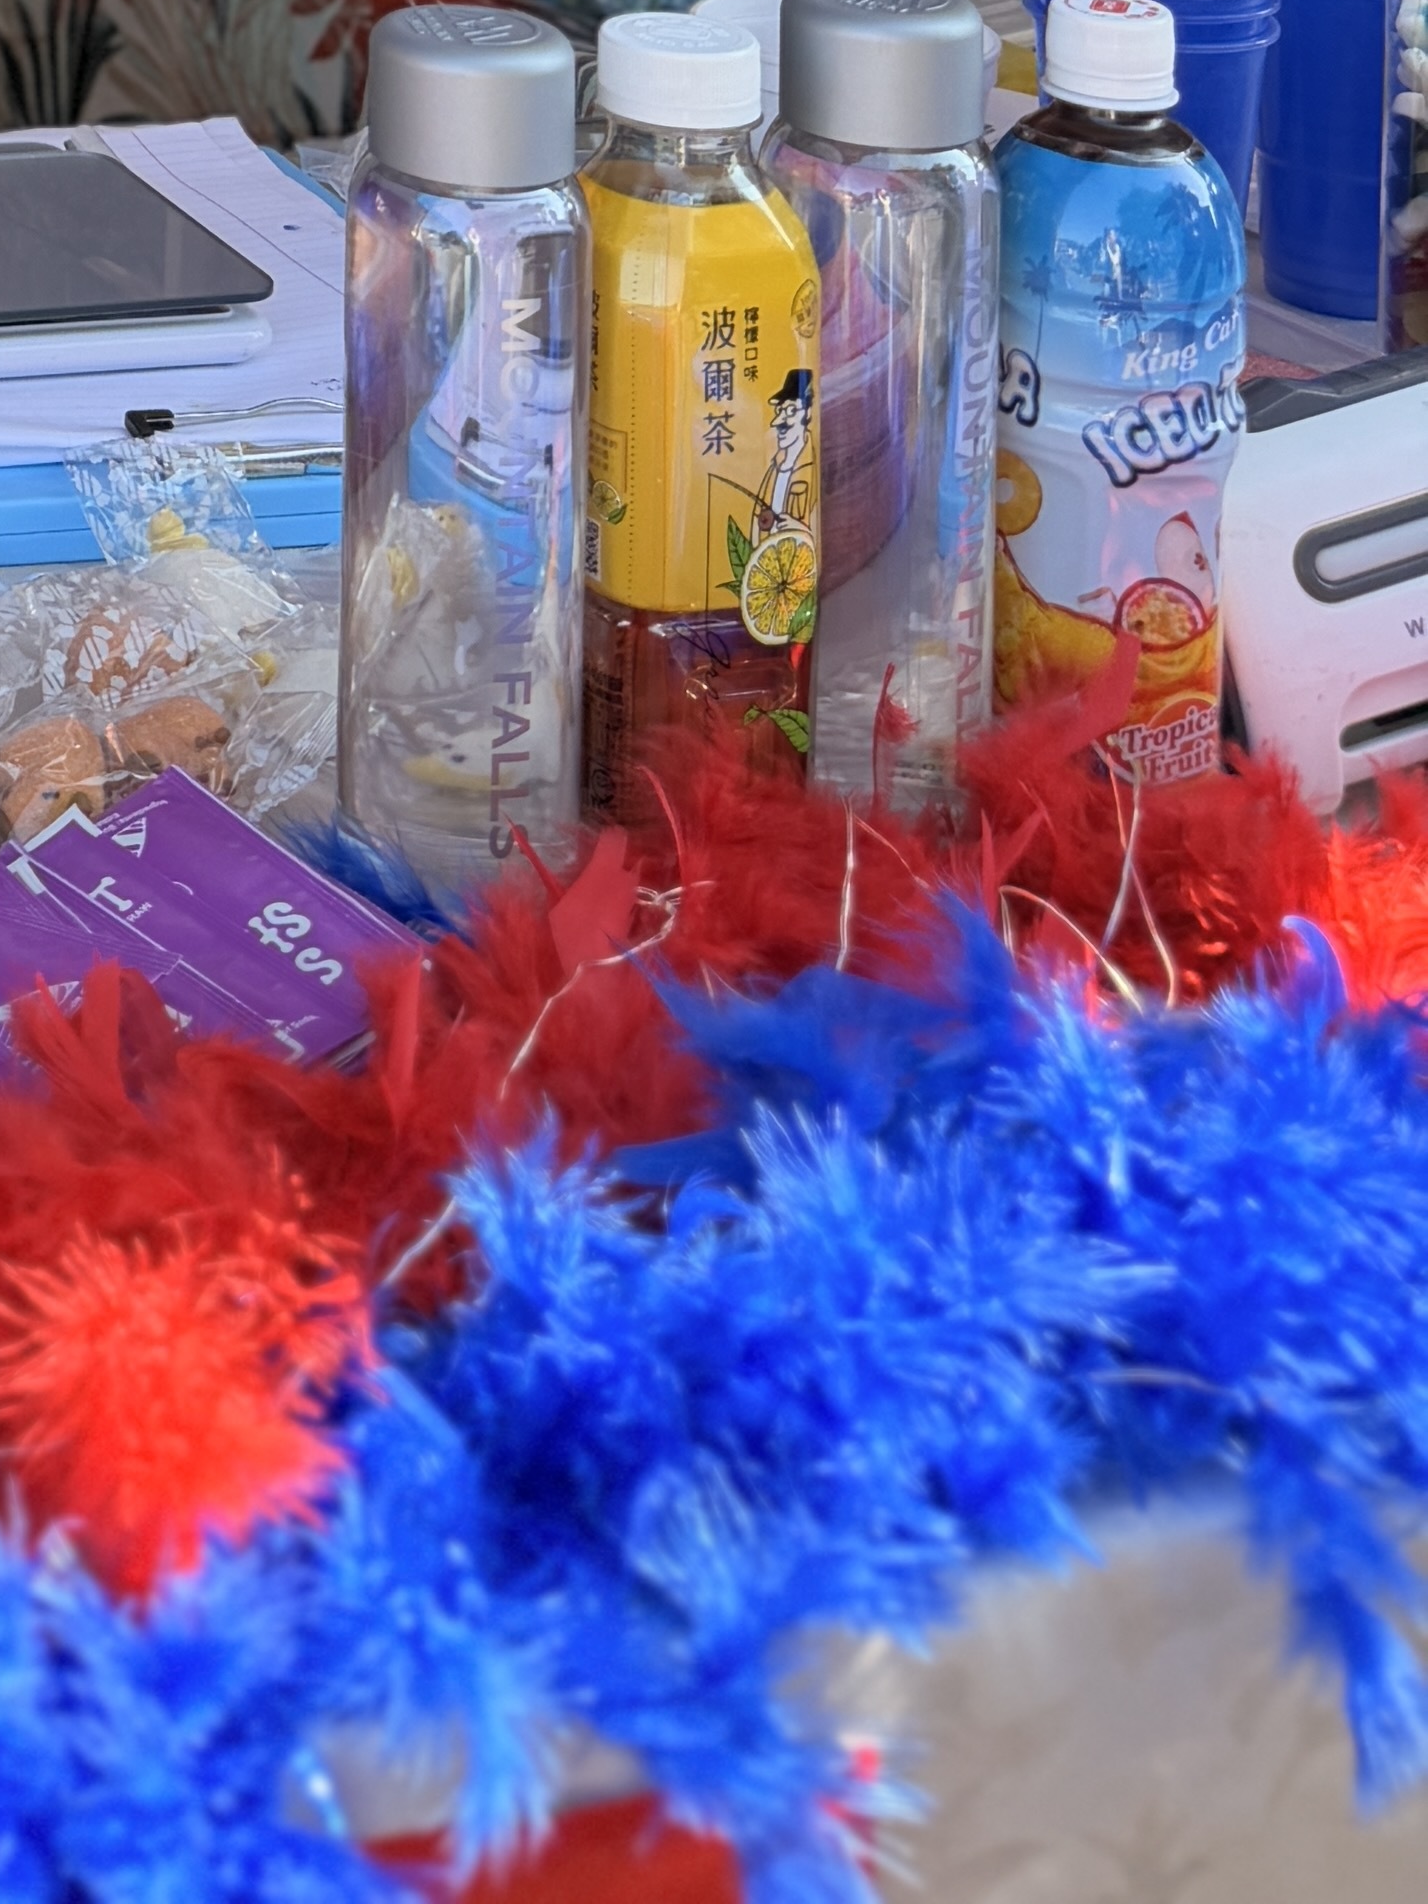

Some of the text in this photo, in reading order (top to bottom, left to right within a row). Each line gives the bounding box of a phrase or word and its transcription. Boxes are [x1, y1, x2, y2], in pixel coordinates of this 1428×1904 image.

[701, 306, 737, 457] 波爾茶
[1121, 346, 1198, 381] King
[1082, 380, 1221, 488] ICED
[955, 607, 985, 754] FALL
[488, 670, 533, 860] FALLS
[1147, 741, 1214, 782] Fruit
